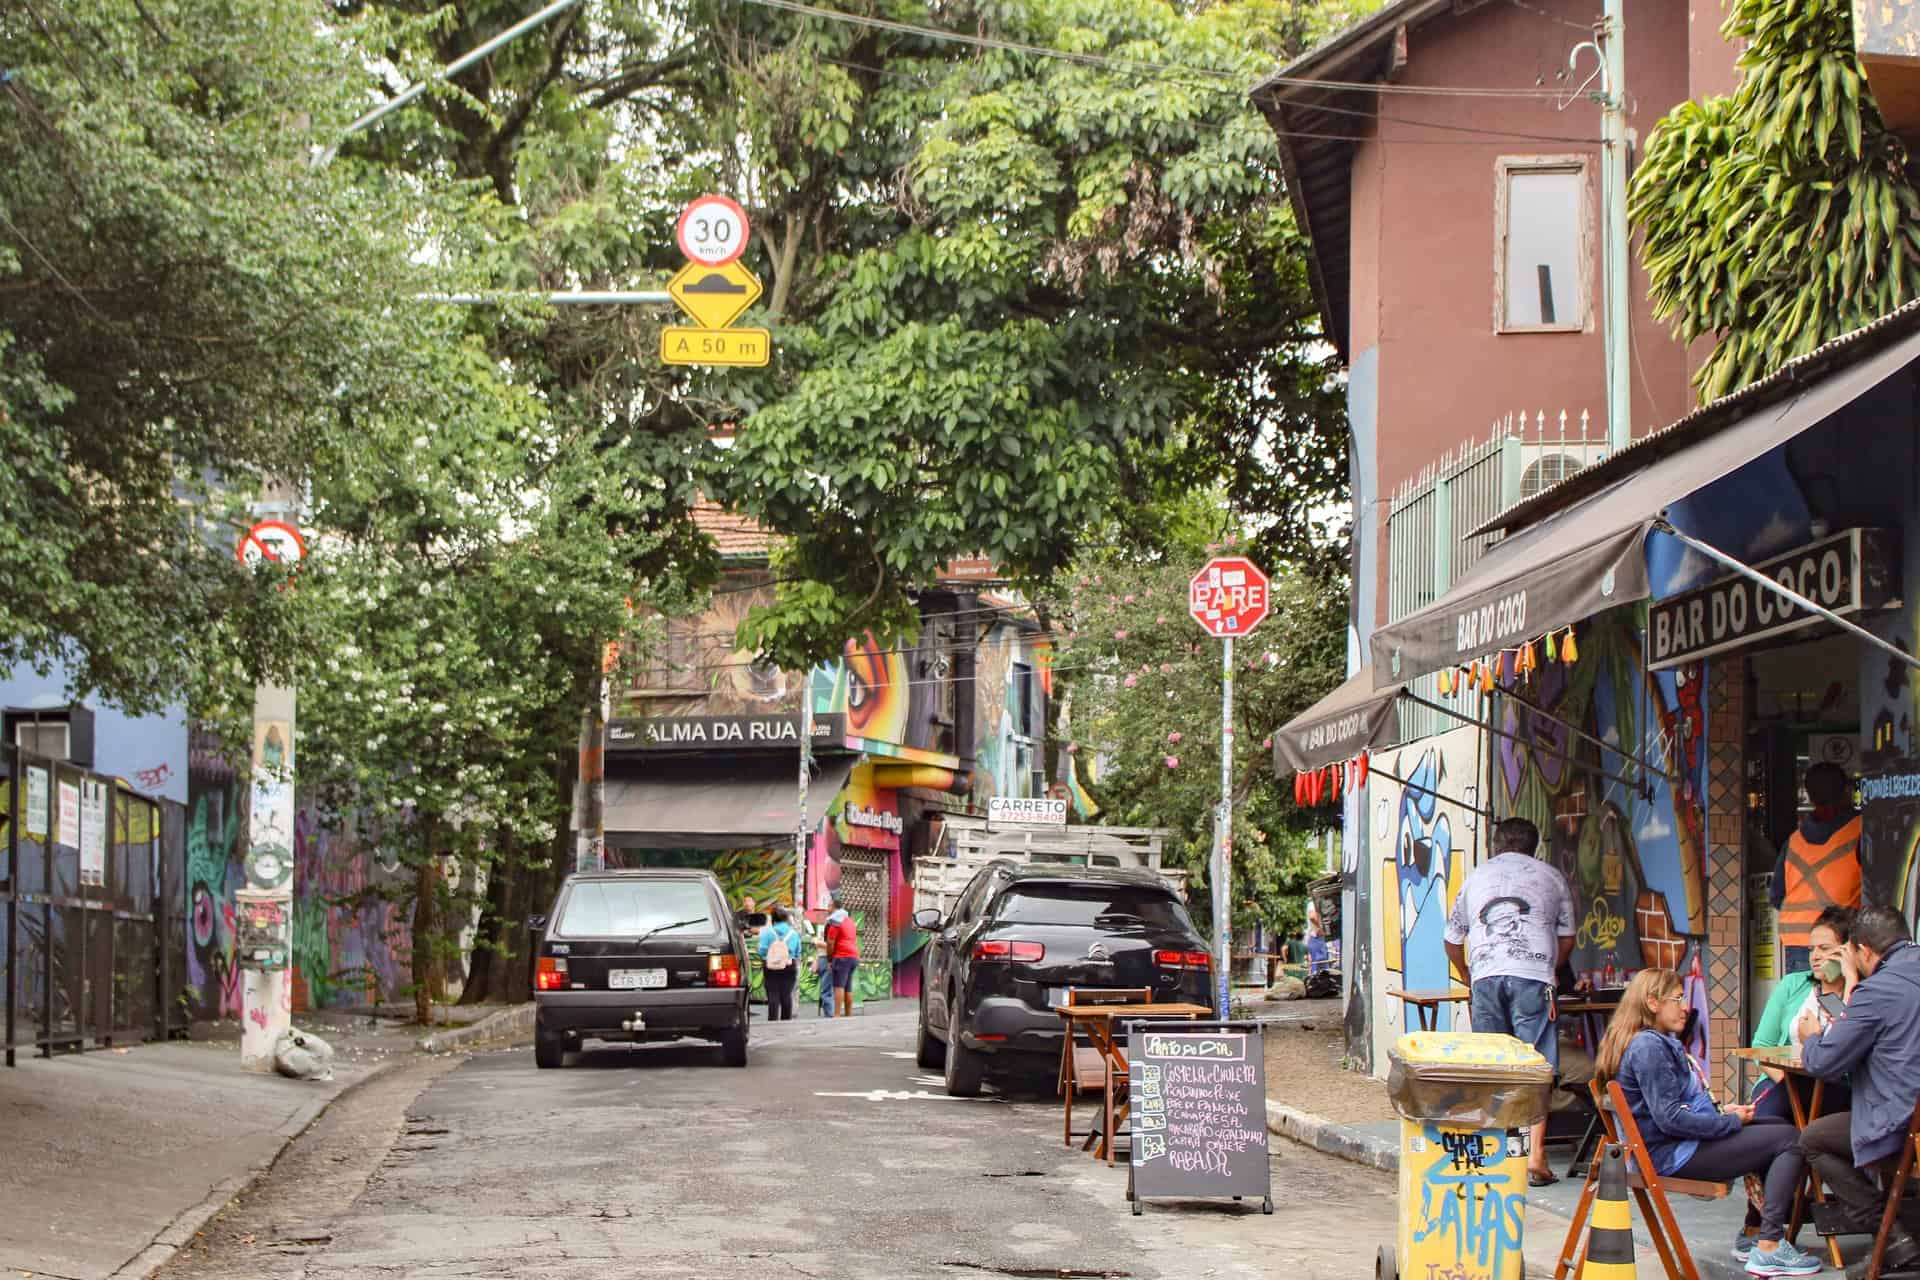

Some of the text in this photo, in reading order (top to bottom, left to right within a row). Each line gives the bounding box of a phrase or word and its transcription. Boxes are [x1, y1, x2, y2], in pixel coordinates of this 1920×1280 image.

[695, 218, 731, 243] 30
[700, 246, 727, 255] km/h
[676, 337, 757, 355] A 50 m
[1194, 584, 1263, 609] PARE
[1656, 549, 1842, 659] BAR DO COCO
[1457, 589, 1527, 652] BAR DO COCO
[648, 720, 798, 742] ALMA DA RUA
[1309, 712, 1359, 750] BAR DO COCO
[990, 799, 1065, 813] CARRETO
[1169, 1150, 1232, 1177] RABADA
